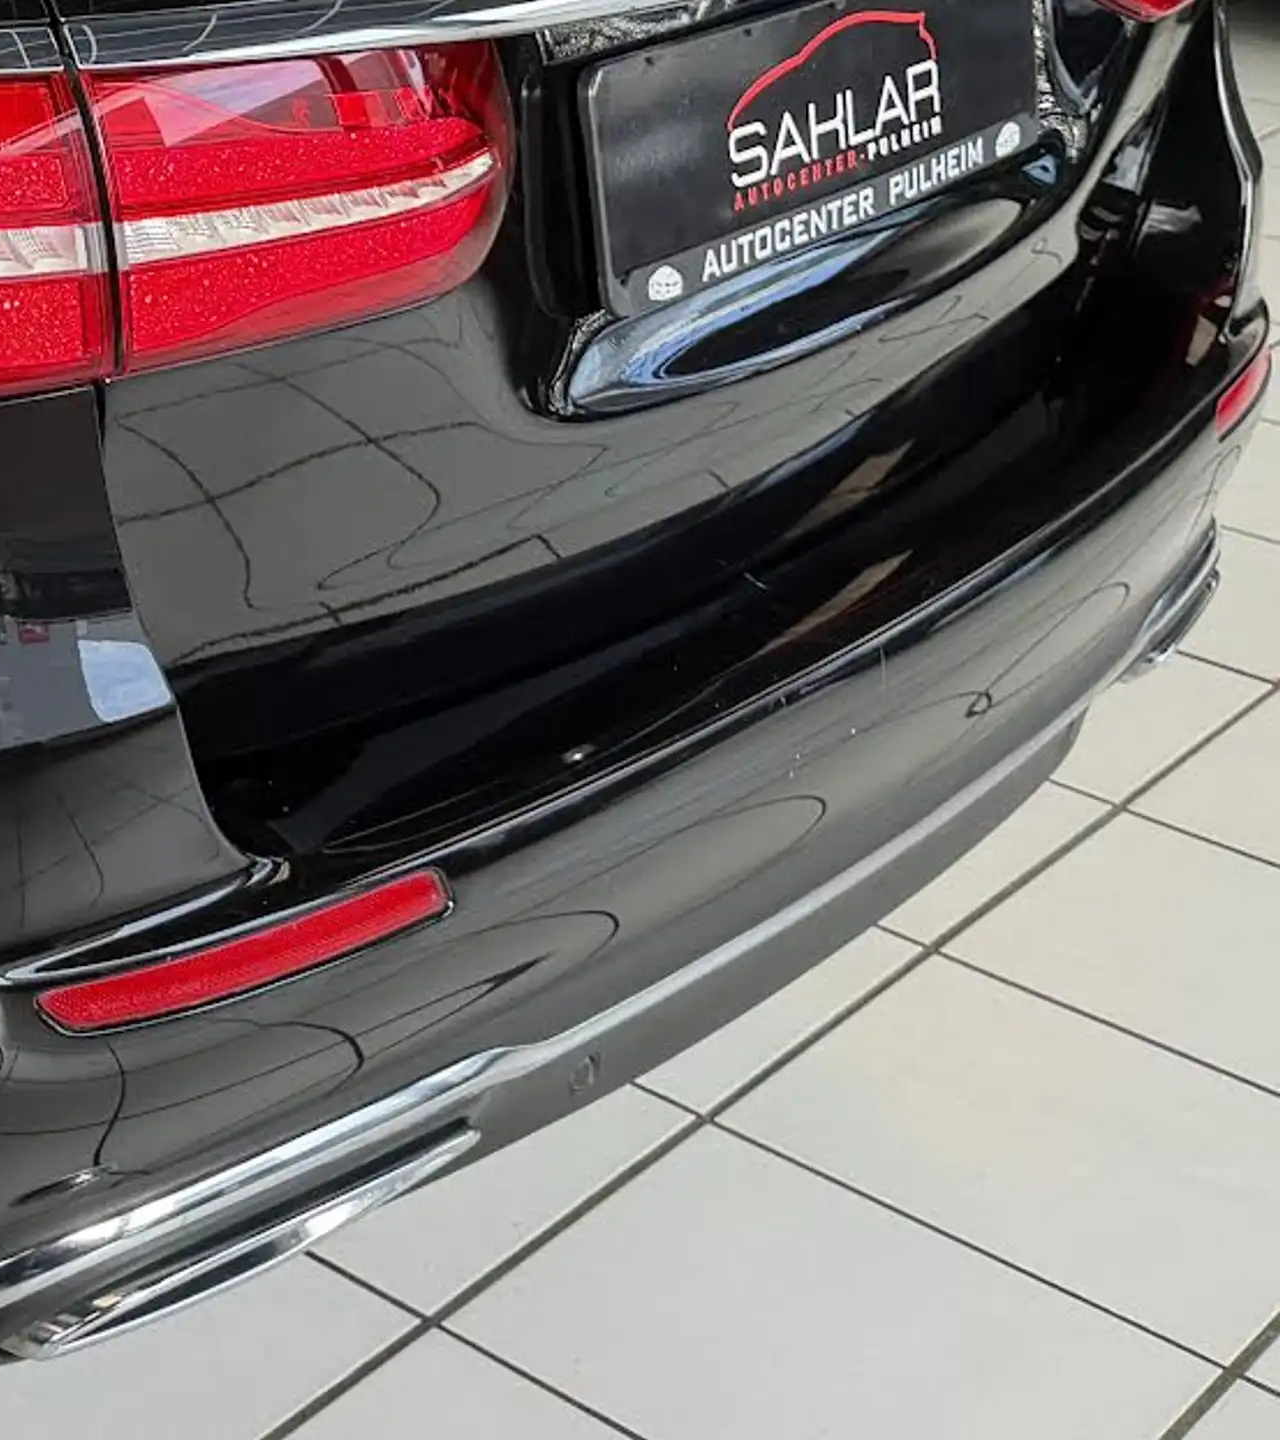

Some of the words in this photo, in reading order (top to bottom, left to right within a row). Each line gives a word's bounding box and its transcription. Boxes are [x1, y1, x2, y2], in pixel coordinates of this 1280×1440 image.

[728, 58, 941, 188] SAHLAR
[701, 186, 876, 282] AUTOCENTER
[888, 137, 984, 207] PULHEIM
